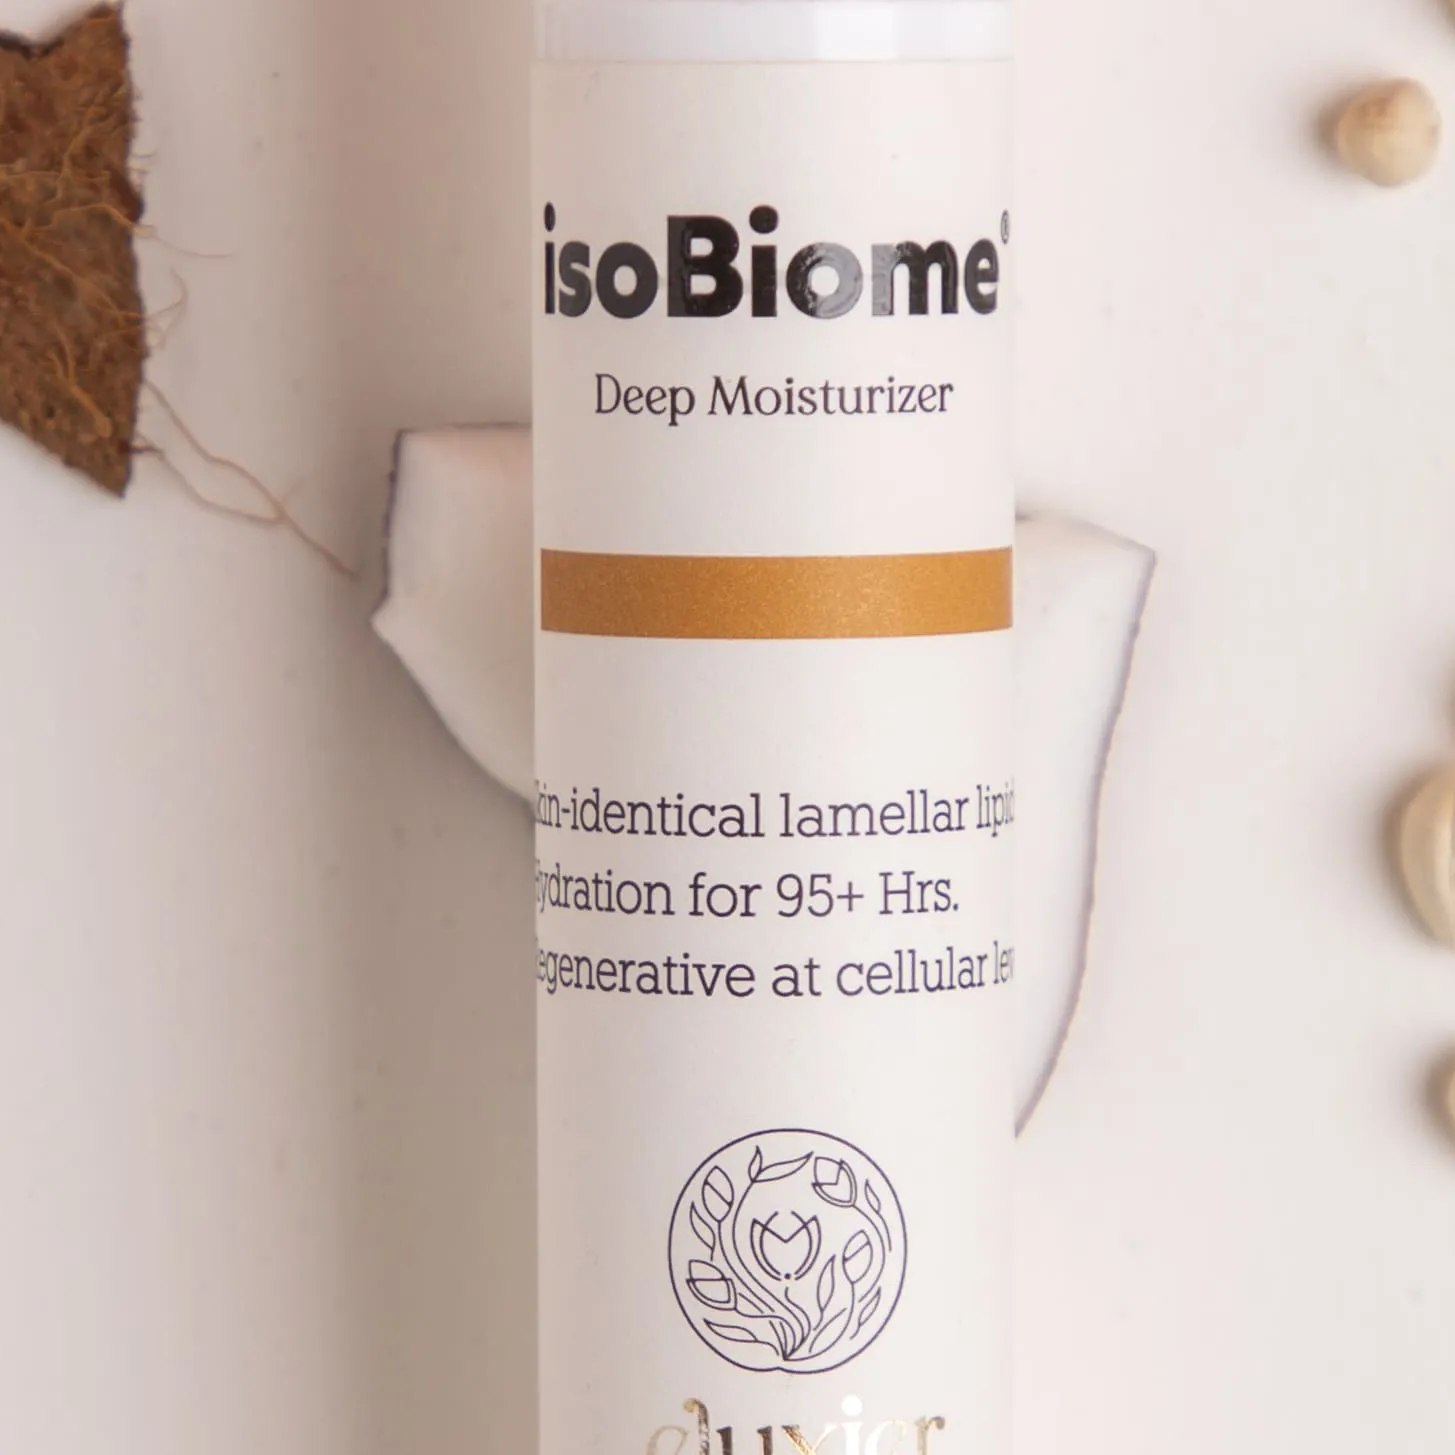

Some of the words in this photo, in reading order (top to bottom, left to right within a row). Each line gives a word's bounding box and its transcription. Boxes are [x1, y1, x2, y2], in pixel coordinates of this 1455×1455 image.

[594, 372, 696, 427] Deep
[707, 374, 955, 417] Moisturizer
[778, 788, 971, 838] lamellar
[687, 871, 763, 919] for
[776, 872, 865, 919] 95+
[878, 869, 960, 916] Hrs.
[535, 938, 757, 998] egenerative
[771, 956, 823, 998] at
[835, 945, 989, 998] cellular
